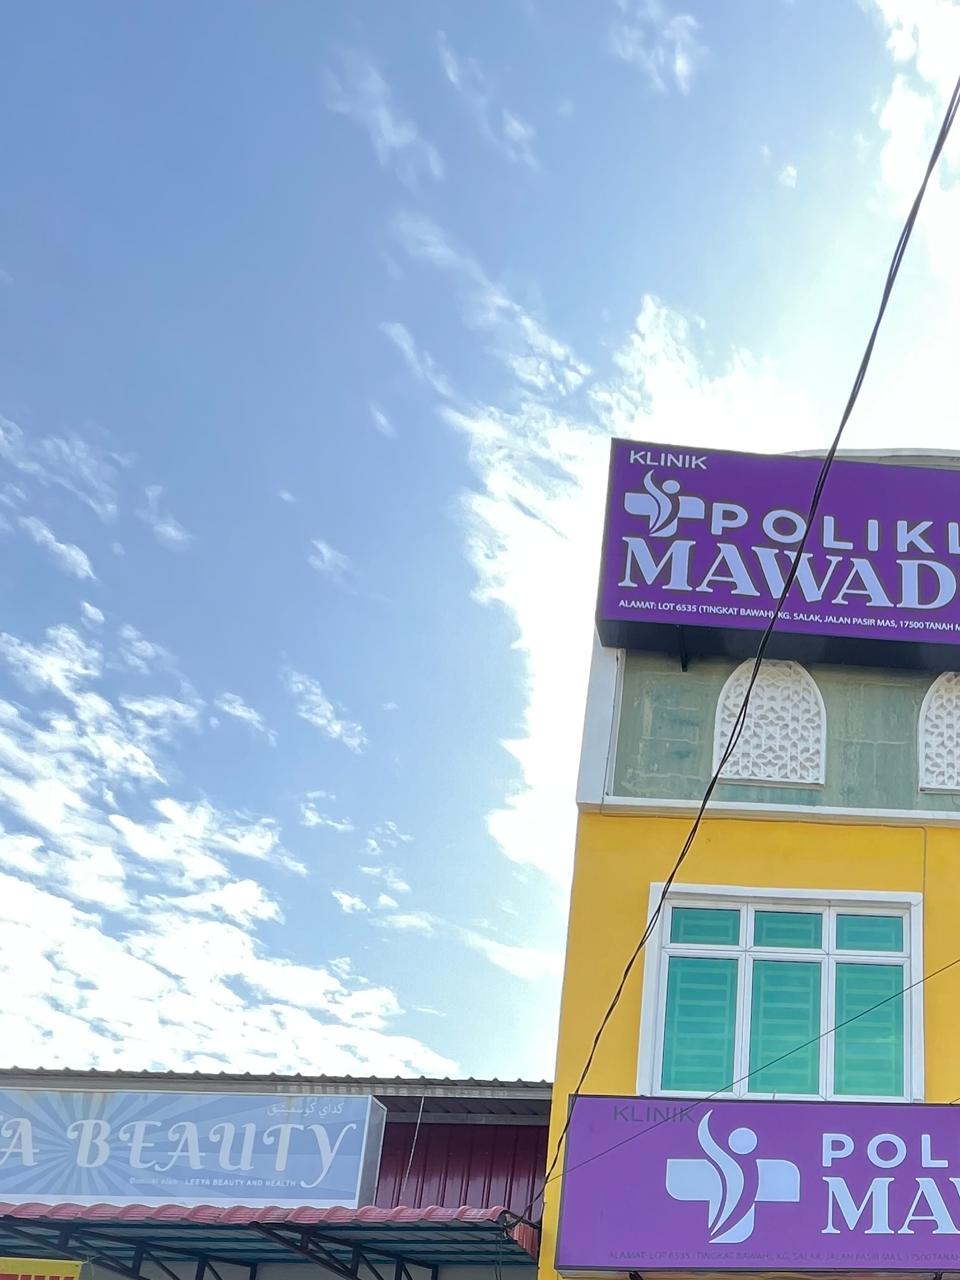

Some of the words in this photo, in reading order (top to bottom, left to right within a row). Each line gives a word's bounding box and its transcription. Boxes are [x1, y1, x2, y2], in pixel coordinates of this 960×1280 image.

[630, 450, 707, 470] KLINIK
[618, 599, 657, 610] ALAMAT:
[658, 603, 674, 611] LOT
[676, 603, 697, 613] 6535
[698, 605, 738, 616] (TINGKAT
[793, 612, 822, 624] SALAK,
[824, 615, 850, 625] JALAN
[852, 617, 875, 627] PASIR
[876, 619, 898, 629] MAS,
[900, 620, 924, 630] 17500
[925, 621, 953, 632] TANAH
[613, 1105, 696, 1124] KLINIK
[66, 1119, 357, 1188] BEAUTY
[212, 1178, 243, 1187] BEAUTY
[246, 1179, 263, 1187] AND
